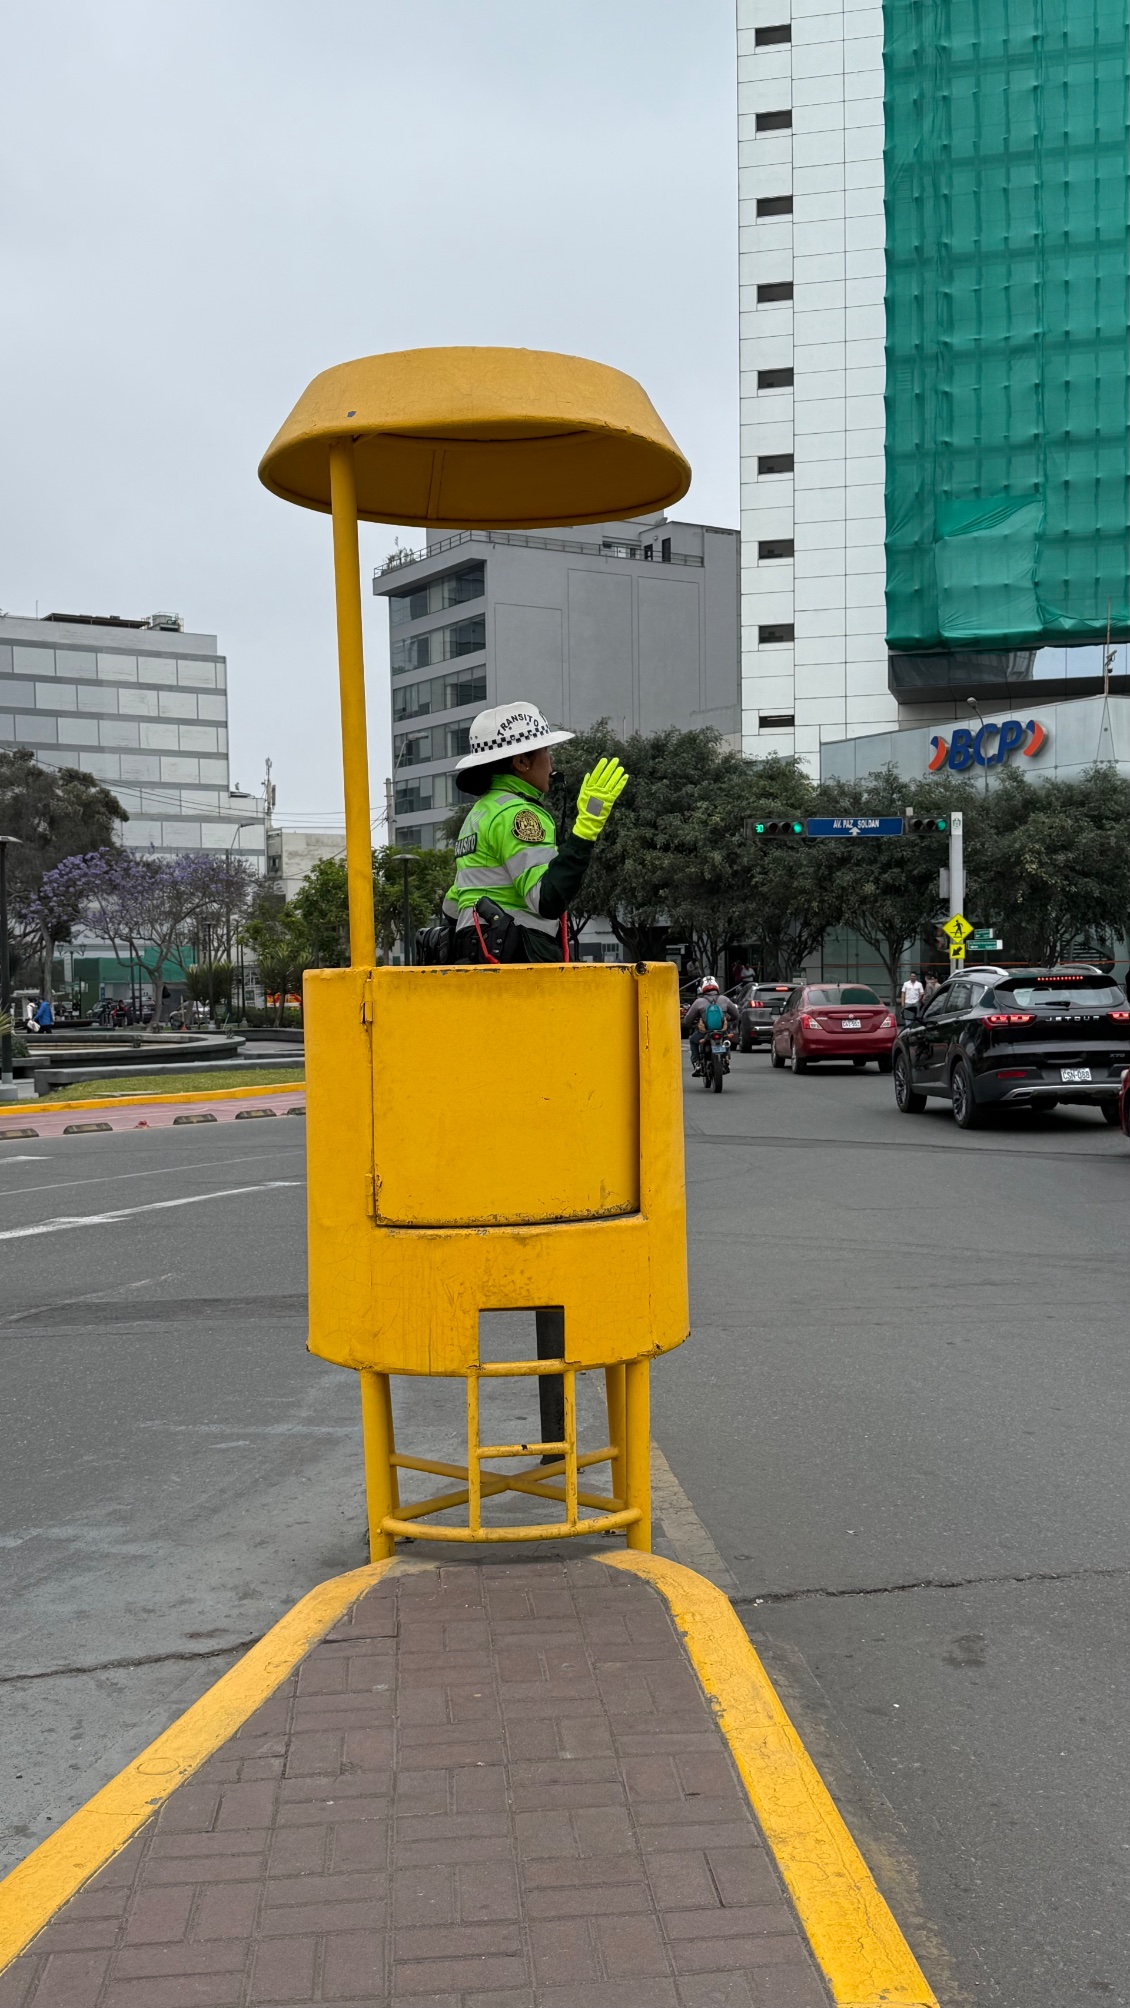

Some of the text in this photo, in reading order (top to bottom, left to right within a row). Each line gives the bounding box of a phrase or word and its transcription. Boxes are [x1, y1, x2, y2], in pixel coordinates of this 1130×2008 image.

[497, 713, 539, 737] TRANSITO
[948, 720, 1023, 771] BCP
[833, 819, 880, 828] AV. PAZ SOLDAN
